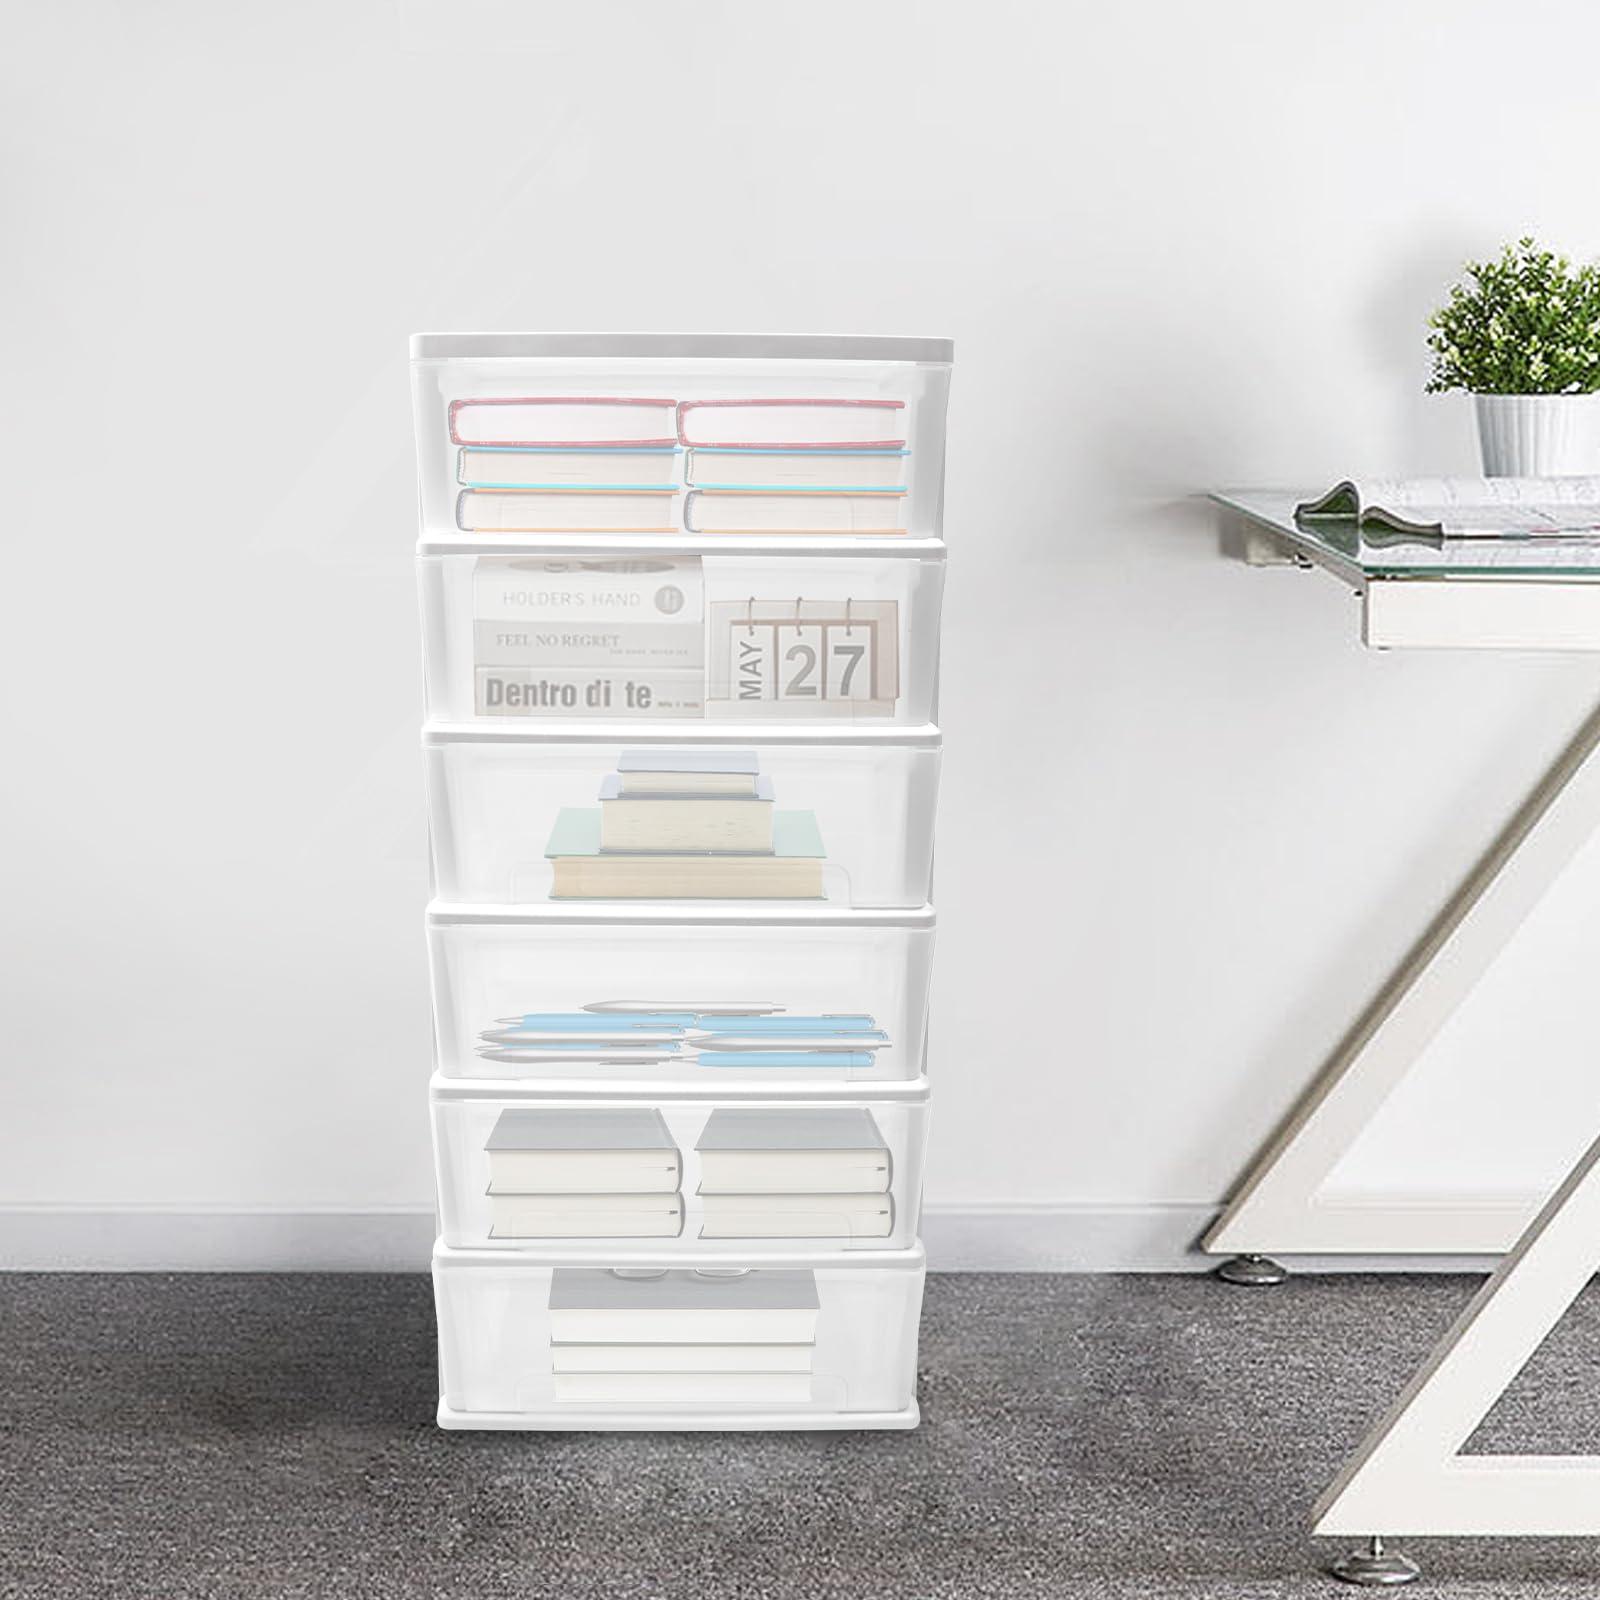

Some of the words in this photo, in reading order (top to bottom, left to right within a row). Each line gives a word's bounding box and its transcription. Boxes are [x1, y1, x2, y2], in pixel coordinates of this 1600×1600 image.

[593, 592, 641, 607] HAND
[496, 634, 531, 647] FEEL
[536, 634, 558, 647] NO
[562, 634, 621, 647] REGRET
[739, 641, 763, 700] MAY
[486, 678, 577, 708] Dentro
[586, 680, 611, 708] di
[625, 681, 652, 709] te
